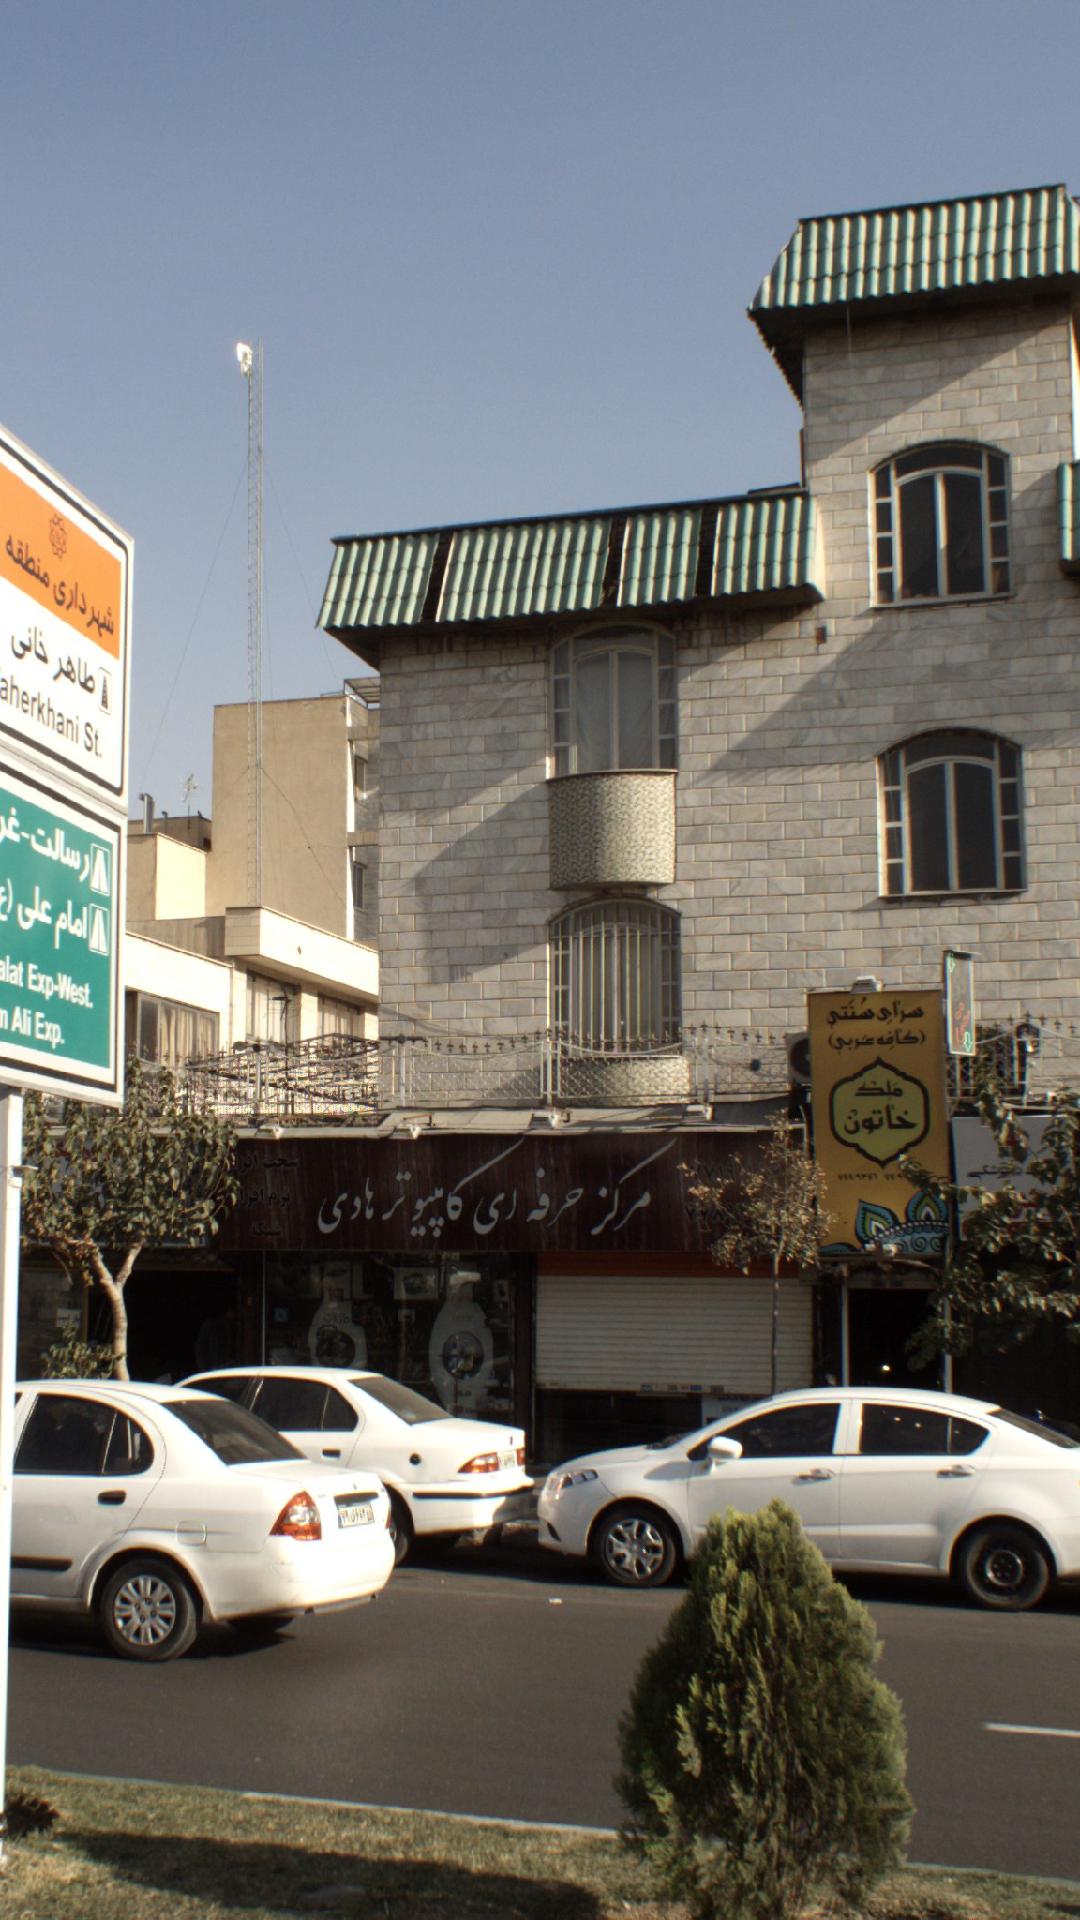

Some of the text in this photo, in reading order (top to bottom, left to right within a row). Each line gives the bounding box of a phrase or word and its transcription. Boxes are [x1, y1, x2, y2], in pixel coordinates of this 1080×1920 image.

[6, 535, 114, 638] شهرداری منطقه
[11, 627, 96, 694] طاهر خانی
[0, 673, 102, 758] aherkhani St.
[17, 886, 52, 930] علی
[55, 900, 87, 949] امام
[11, 1006, 31, 1036] Ali
[35, 1012, 65, 1049] Exp.
[318, 1177, 374, 1234] هادی
[526, 1167, 584, 1228] حرفه
[591, 1138, 677, 1236] مرکز
